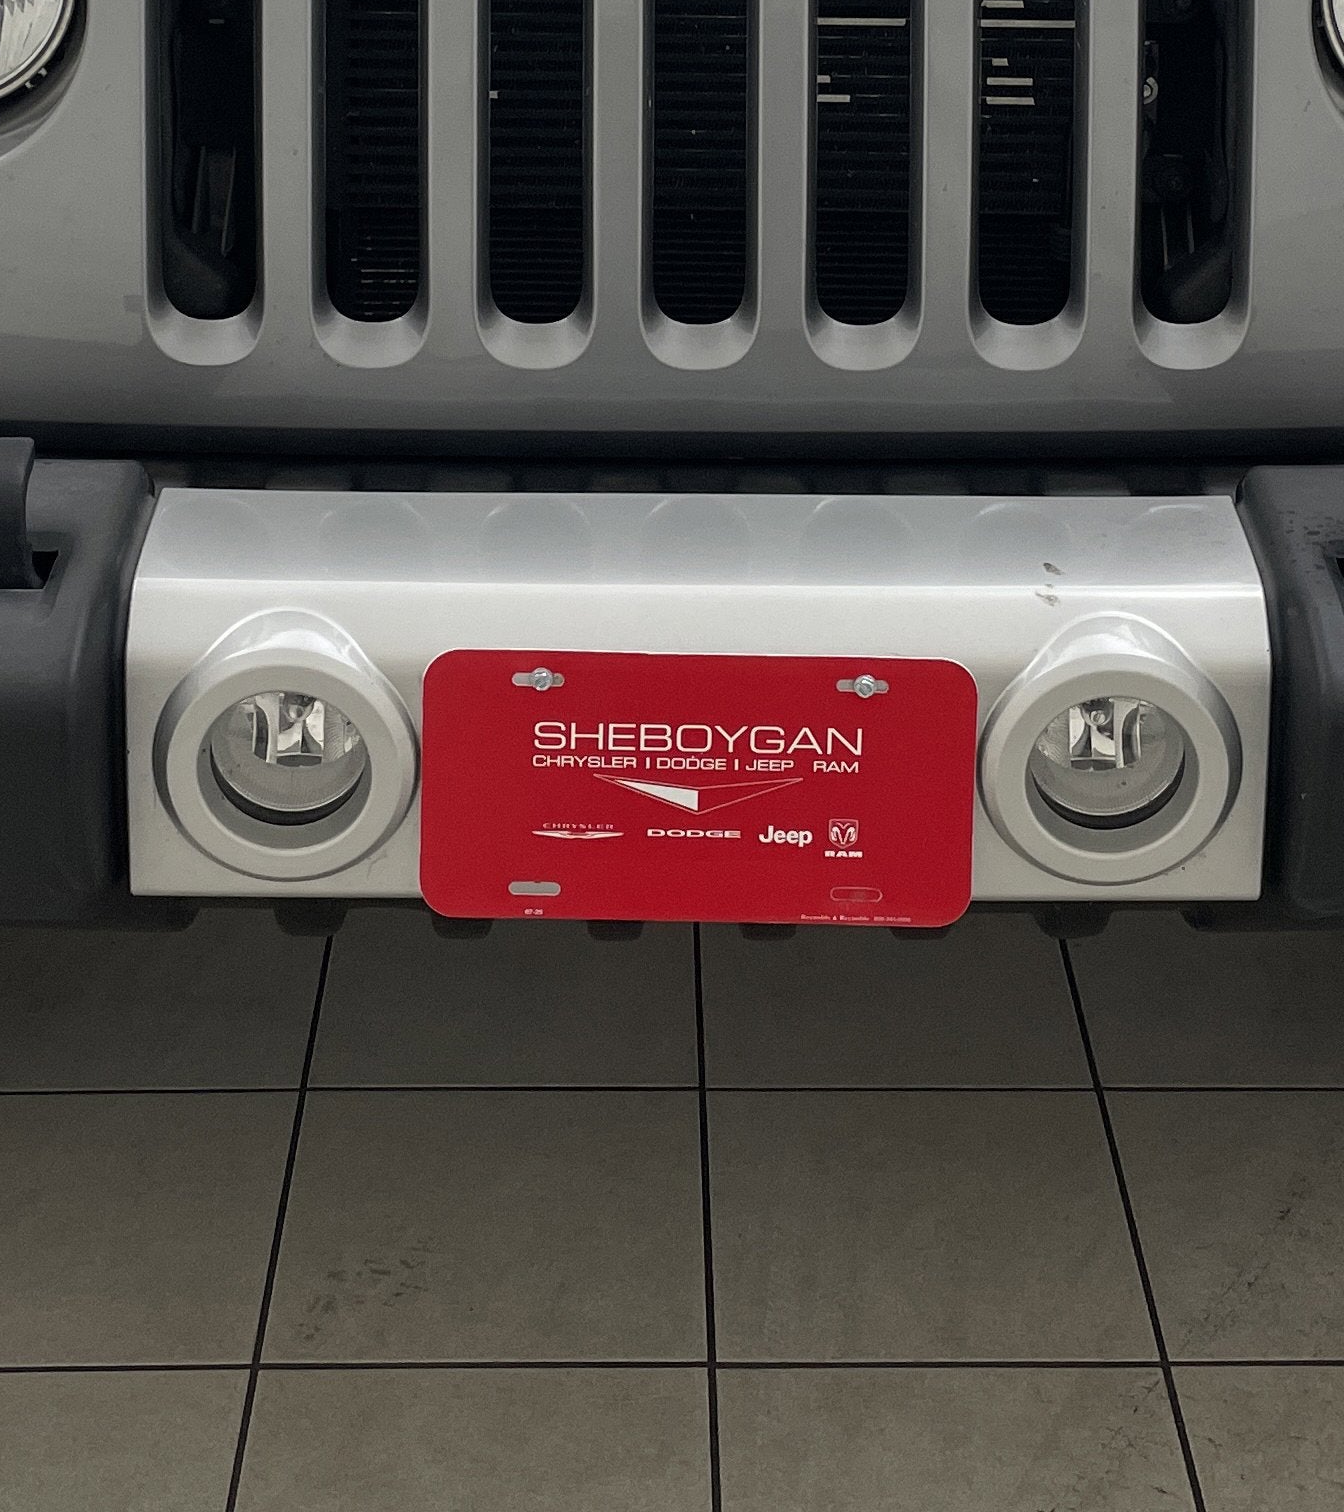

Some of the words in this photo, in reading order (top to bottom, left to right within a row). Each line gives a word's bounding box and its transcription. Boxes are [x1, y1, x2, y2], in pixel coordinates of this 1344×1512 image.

[534, 721, 863, 756] SHEBOYGAN
[532, 755, 637, 769] CHRYSLER
[656, 757, 727, 770] DODGE
[745, 759, 794, 772] JEEP
[813, 760, 859, 773] RAM
[647, 828, 741, 838] DODGE
[758, 825, 813, 848] Jeep
[824, 850, 863, 858] RAM
